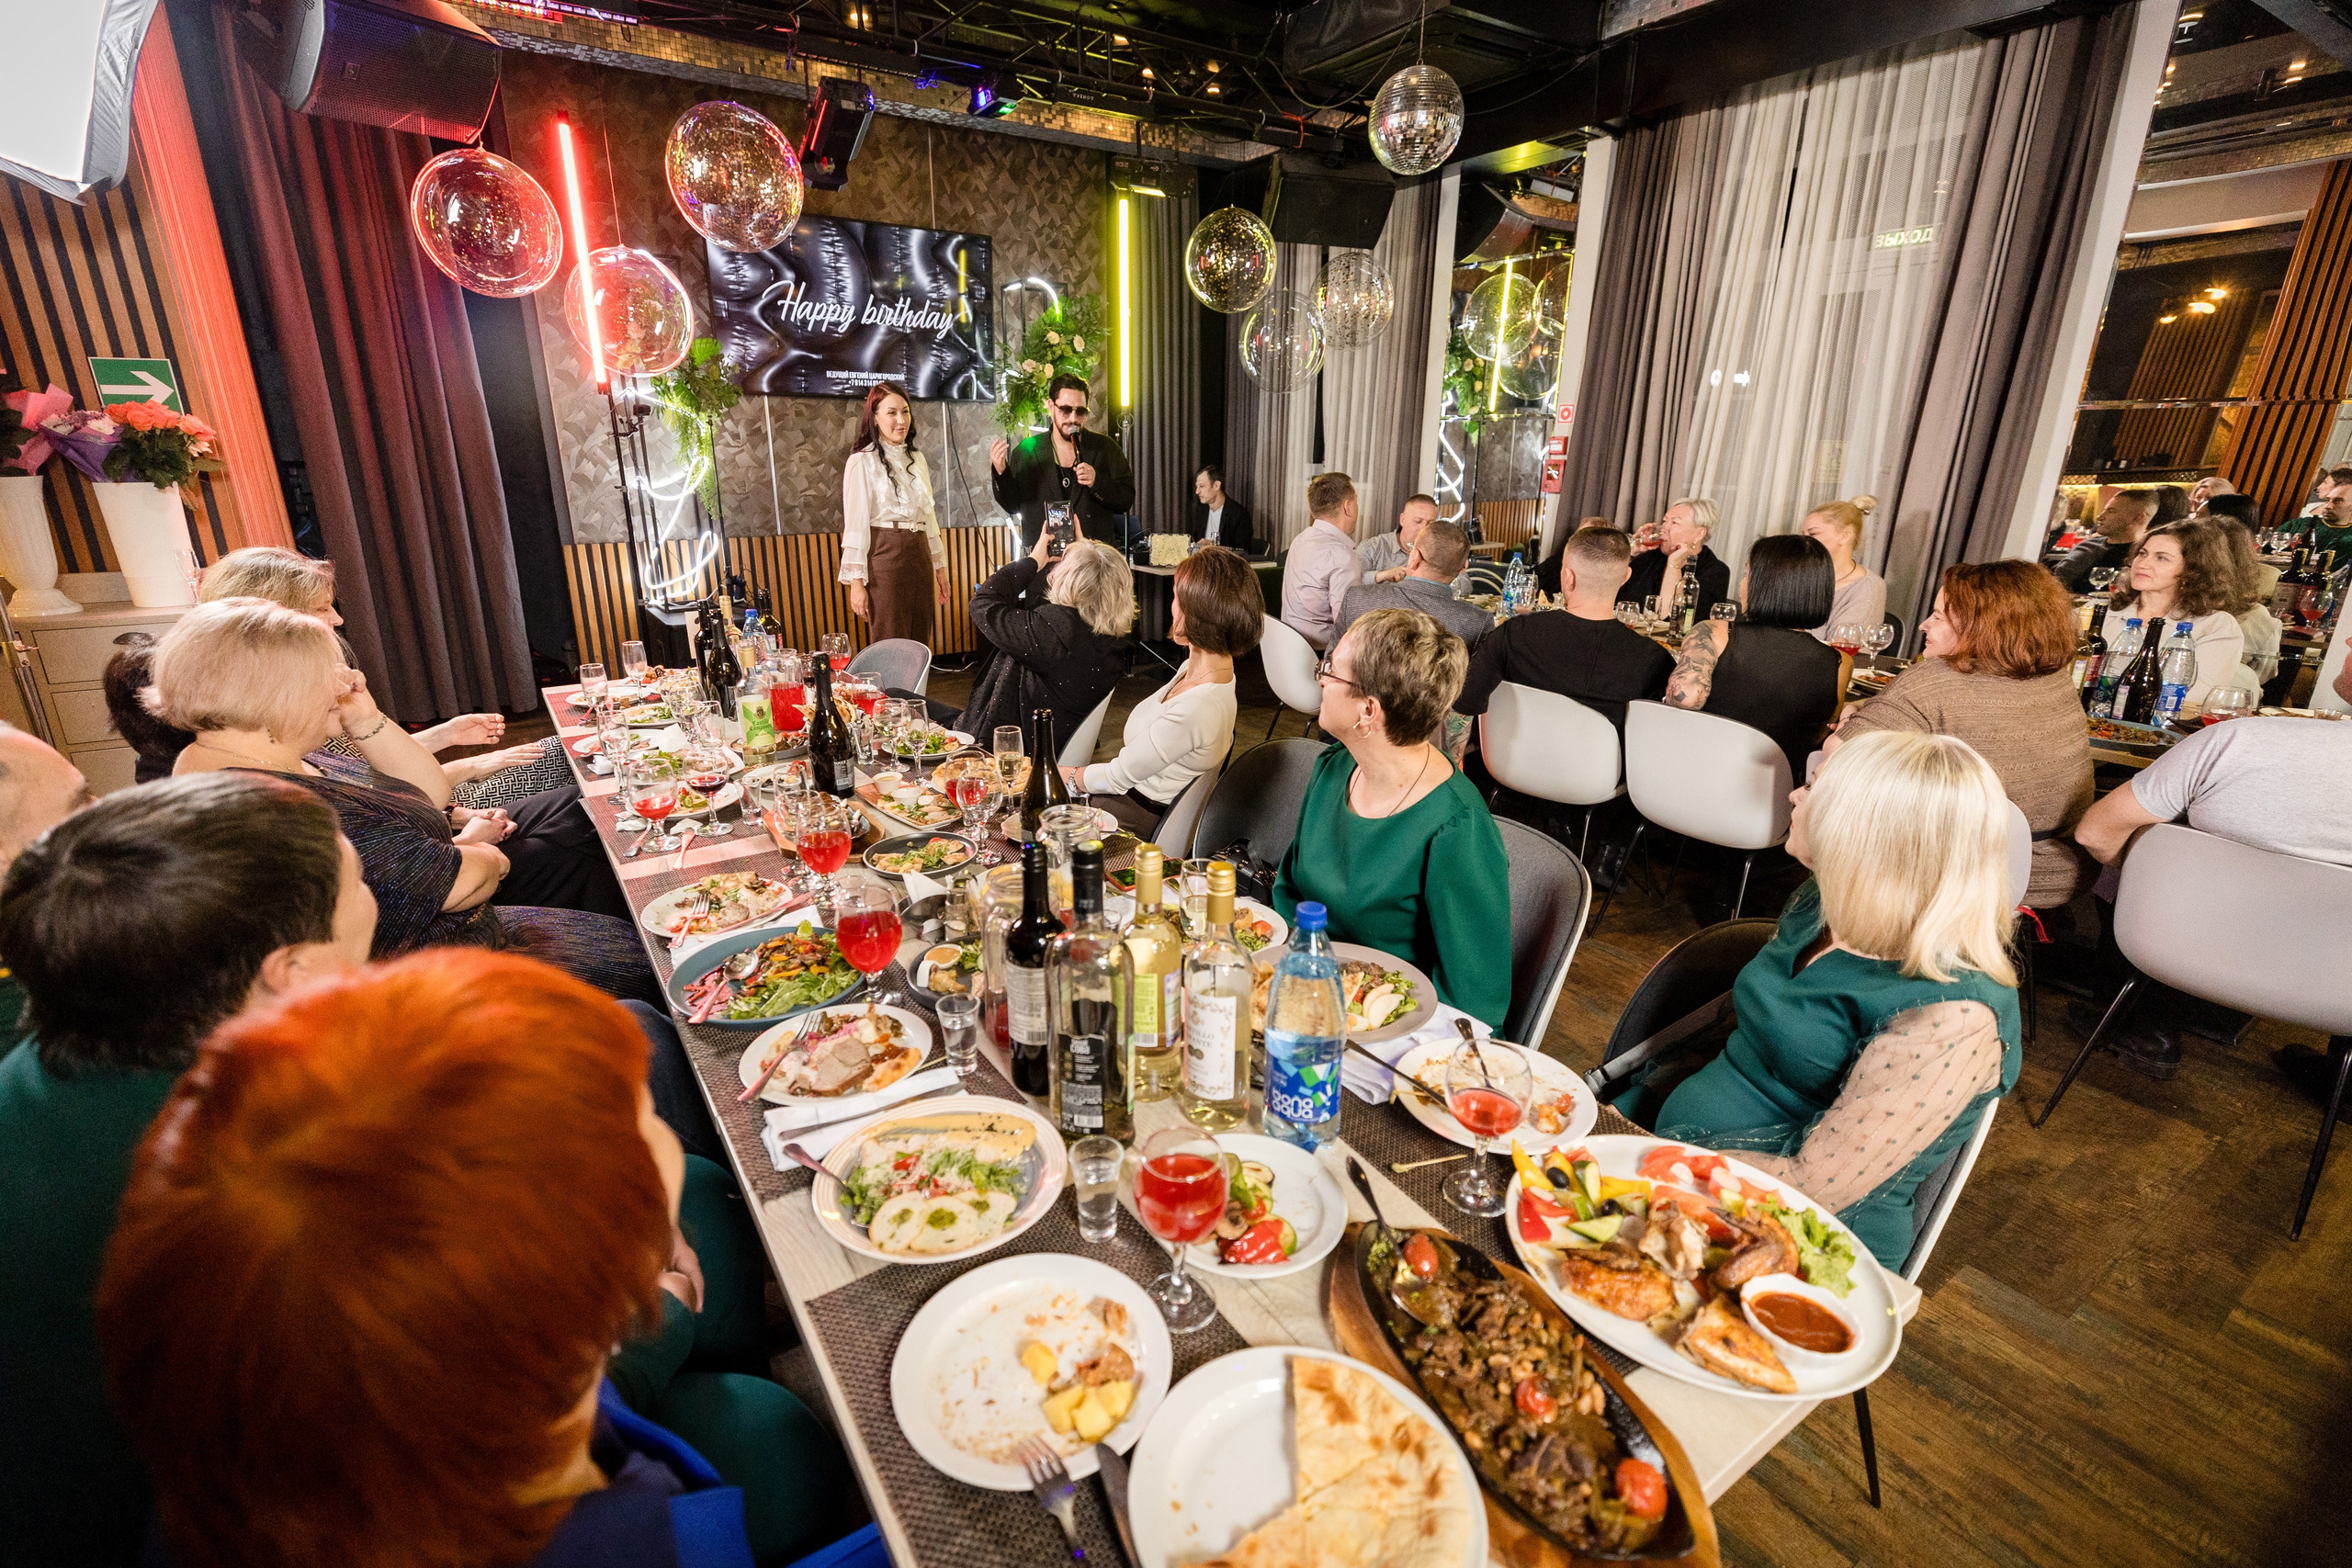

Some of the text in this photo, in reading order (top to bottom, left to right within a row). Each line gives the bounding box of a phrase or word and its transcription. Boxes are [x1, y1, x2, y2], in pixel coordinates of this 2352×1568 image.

[1875, 227, 1933, 248] ВЫХОД
[762, 280, 953, 339] Happy birthday
[826, 370, 849, 379] ВЕДУЩИЙ
[849, 371, 868, 380] ЕВГЕНИЙ
